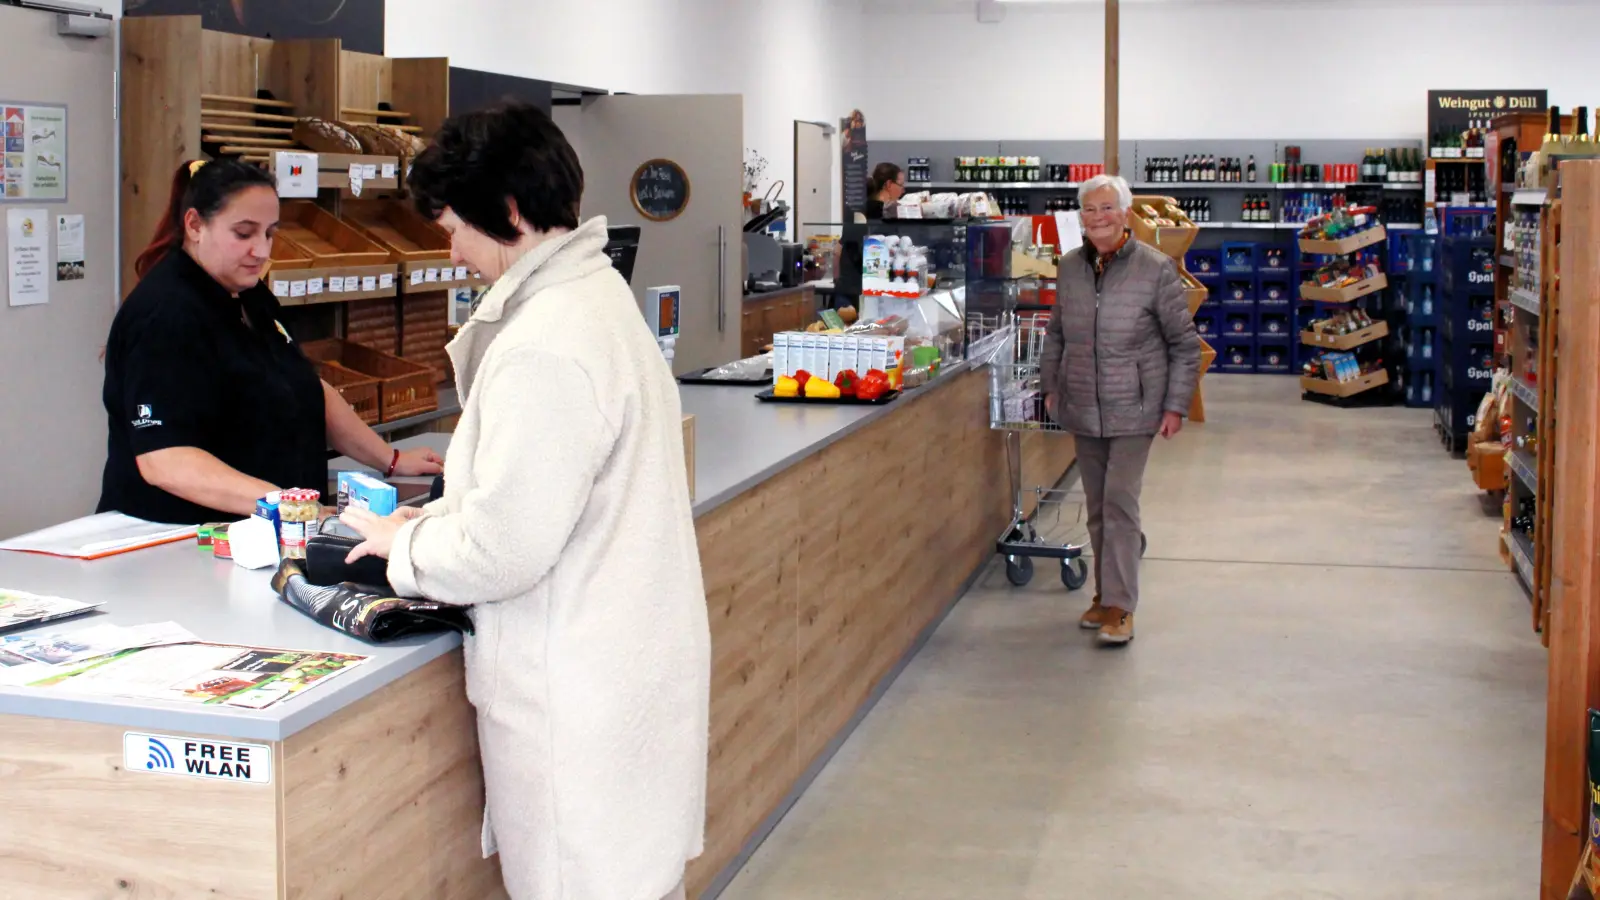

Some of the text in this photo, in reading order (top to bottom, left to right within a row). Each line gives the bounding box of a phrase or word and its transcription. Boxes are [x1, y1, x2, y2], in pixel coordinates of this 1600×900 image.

[1438, 96, 1537, 111] Weingut Düll
[1467, 270, 1494, 284] Spal
[1467, 319, 1493, 332] Spal
[1467, 366, 1493, 380] Spal
[185, 742, 250, 762] FREE
[186, 759, 251, 778] WLAN
